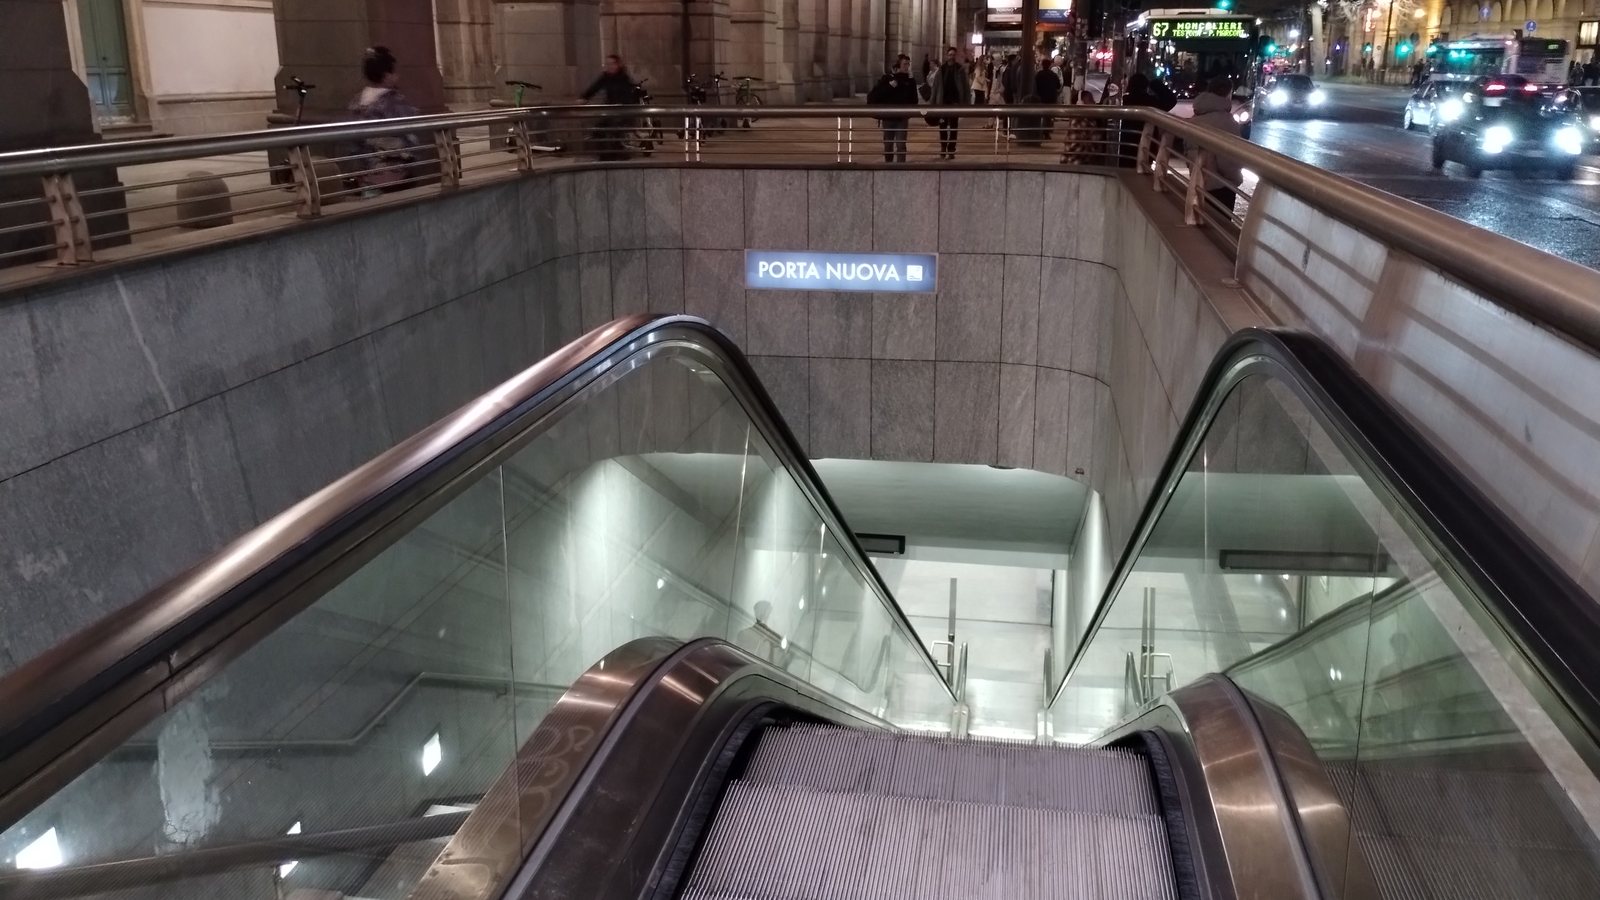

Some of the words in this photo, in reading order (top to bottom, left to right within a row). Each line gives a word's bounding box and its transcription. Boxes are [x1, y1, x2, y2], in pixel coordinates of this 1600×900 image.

[1154, 22, 1169, 37] 67
[759, 261, 820, 279] PORTA
[826, 263, 900, 281] NUOVA
